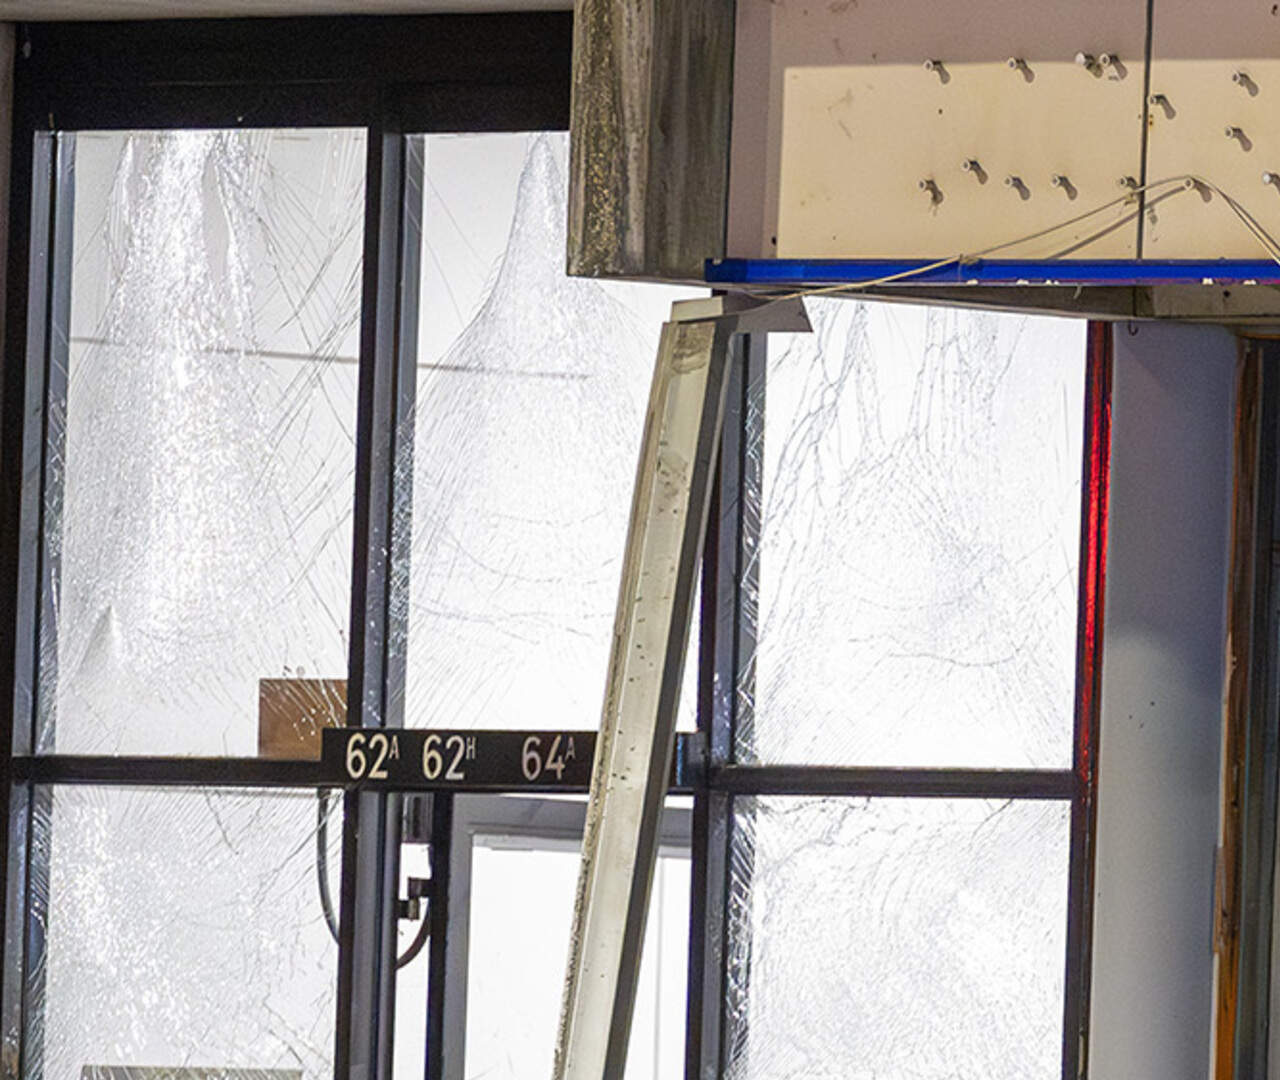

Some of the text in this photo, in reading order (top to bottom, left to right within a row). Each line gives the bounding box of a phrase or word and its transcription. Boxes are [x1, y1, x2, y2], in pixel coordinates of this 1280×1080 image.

[346, 732, 576, 781] 62A 62H 64A
